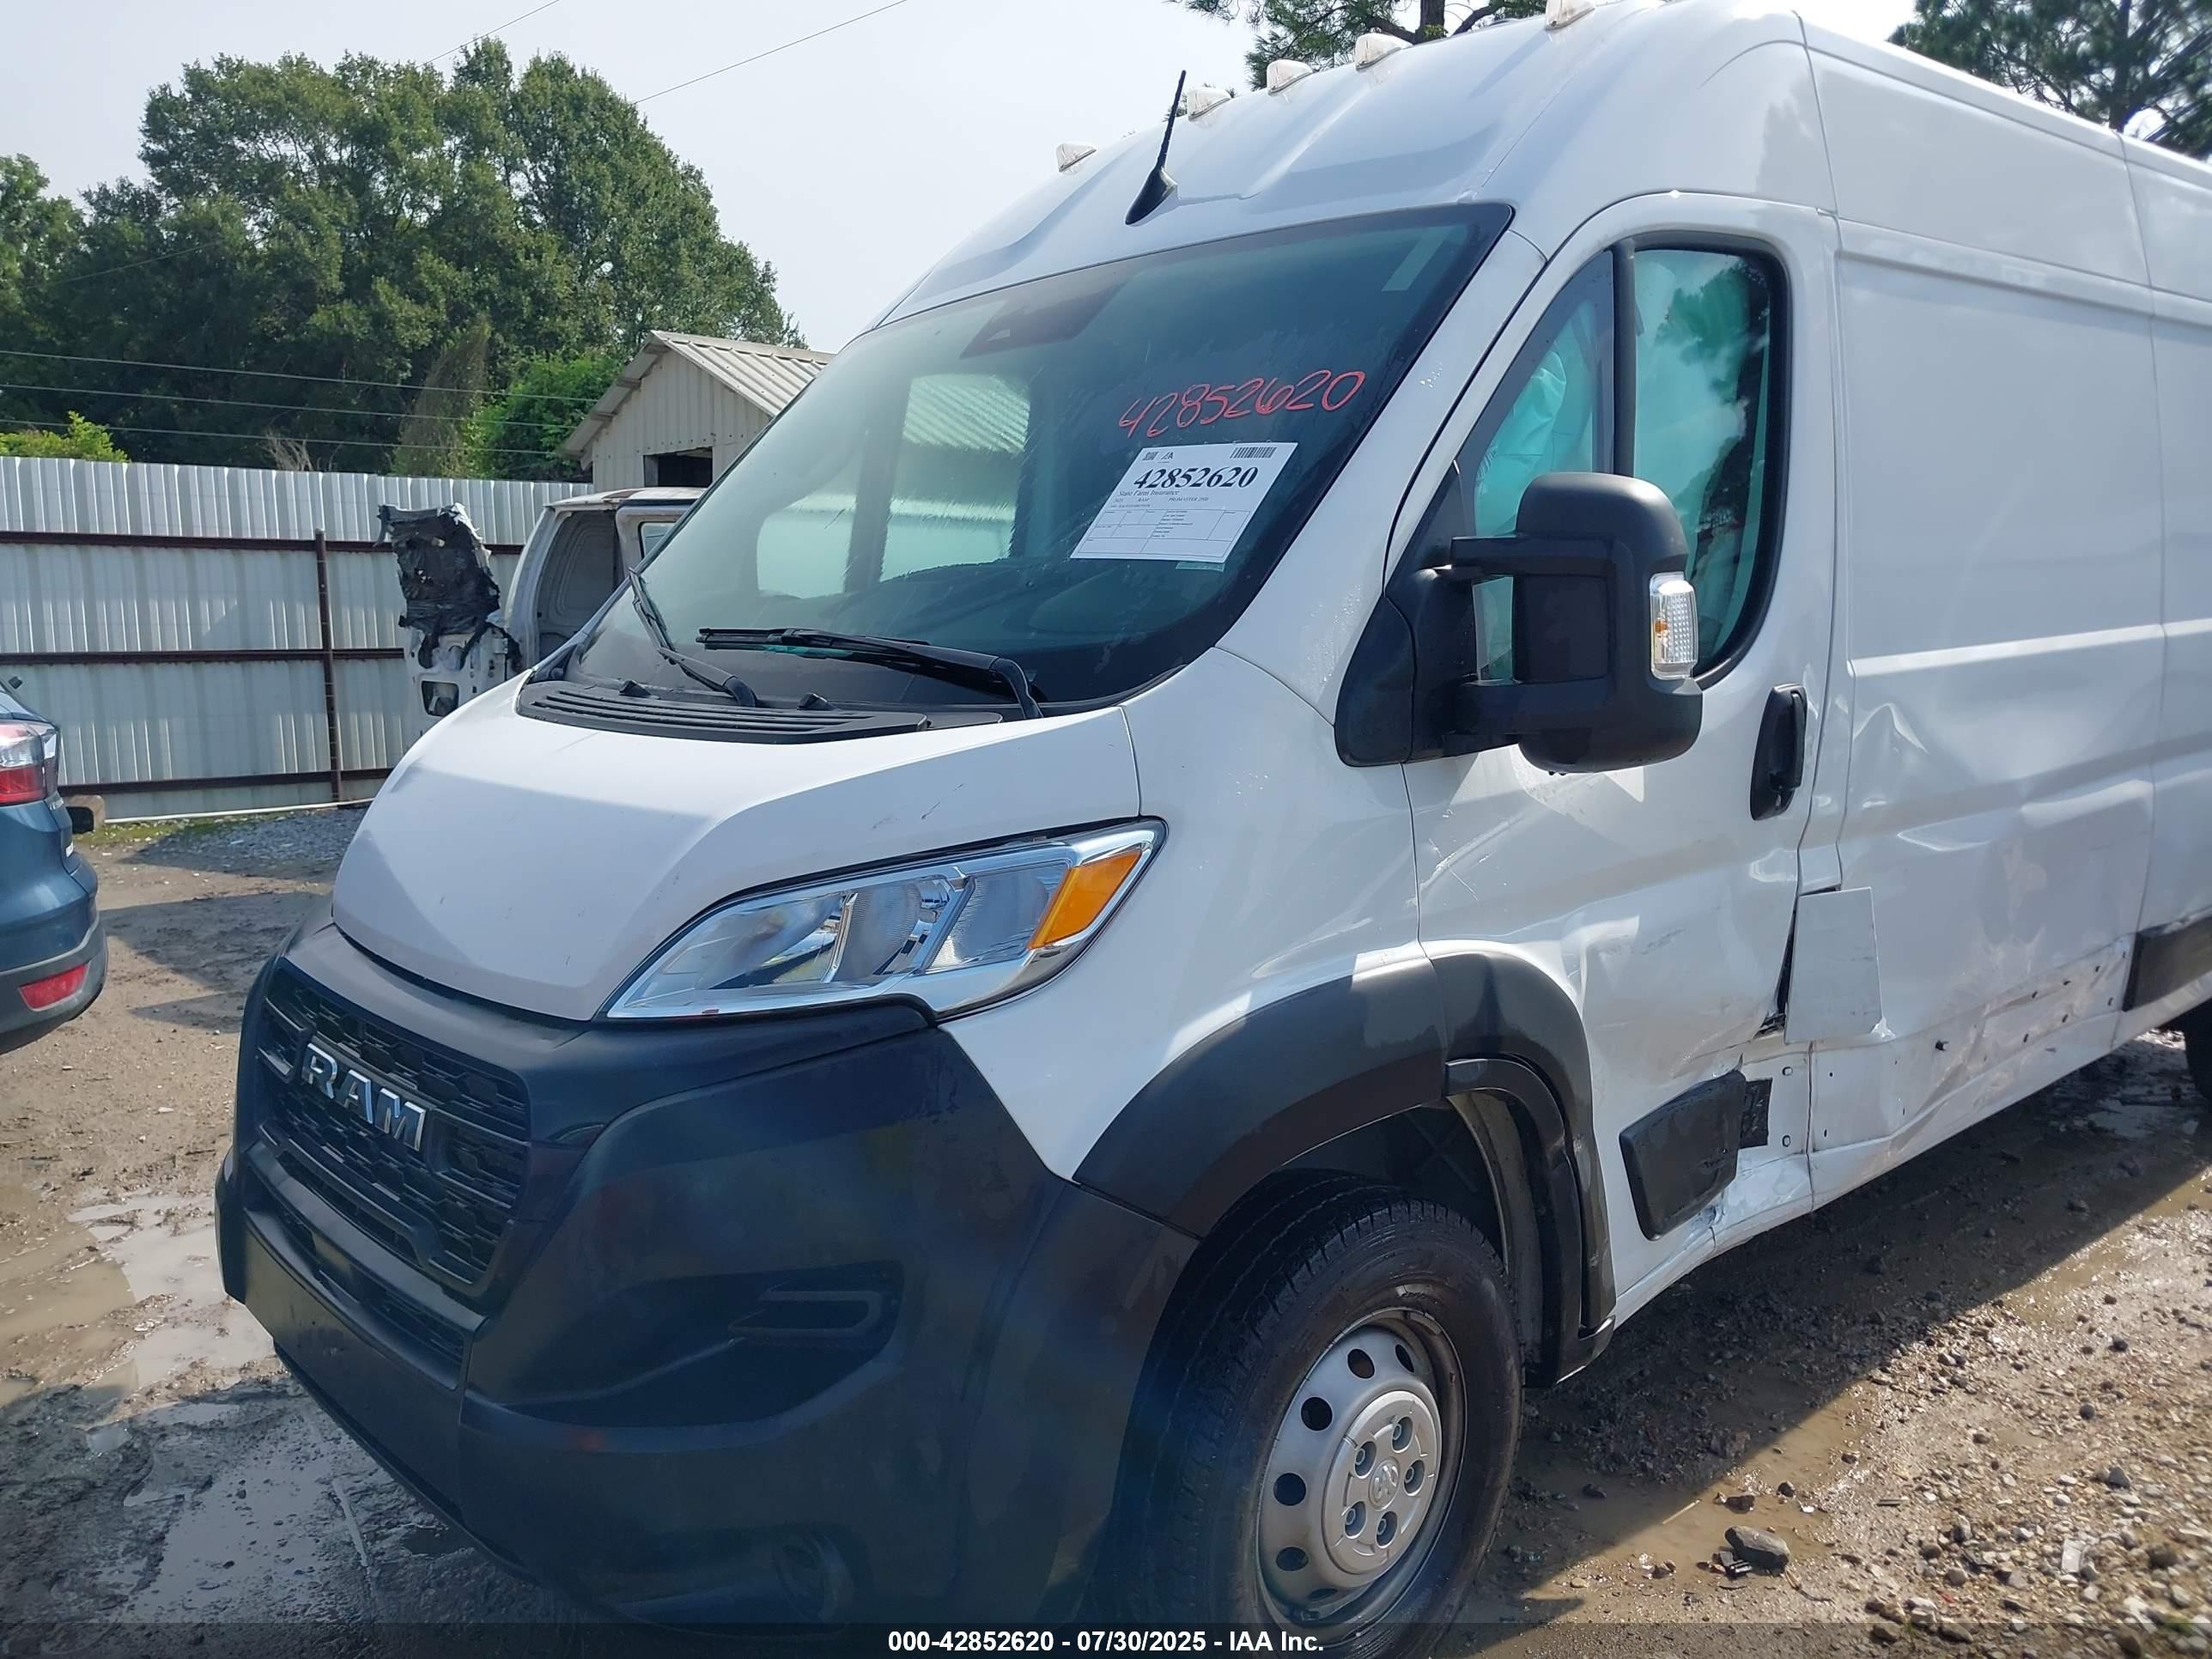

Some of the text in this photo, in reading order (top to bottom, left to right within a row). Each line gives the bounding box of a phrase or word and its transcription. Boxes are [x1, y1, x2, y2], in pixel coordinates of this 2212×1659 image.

[1118, 369, 1366, 439] 42852620
[1133, 466, 1258, 489] 42852620
[301, 1042, 428, 1152] RAM
